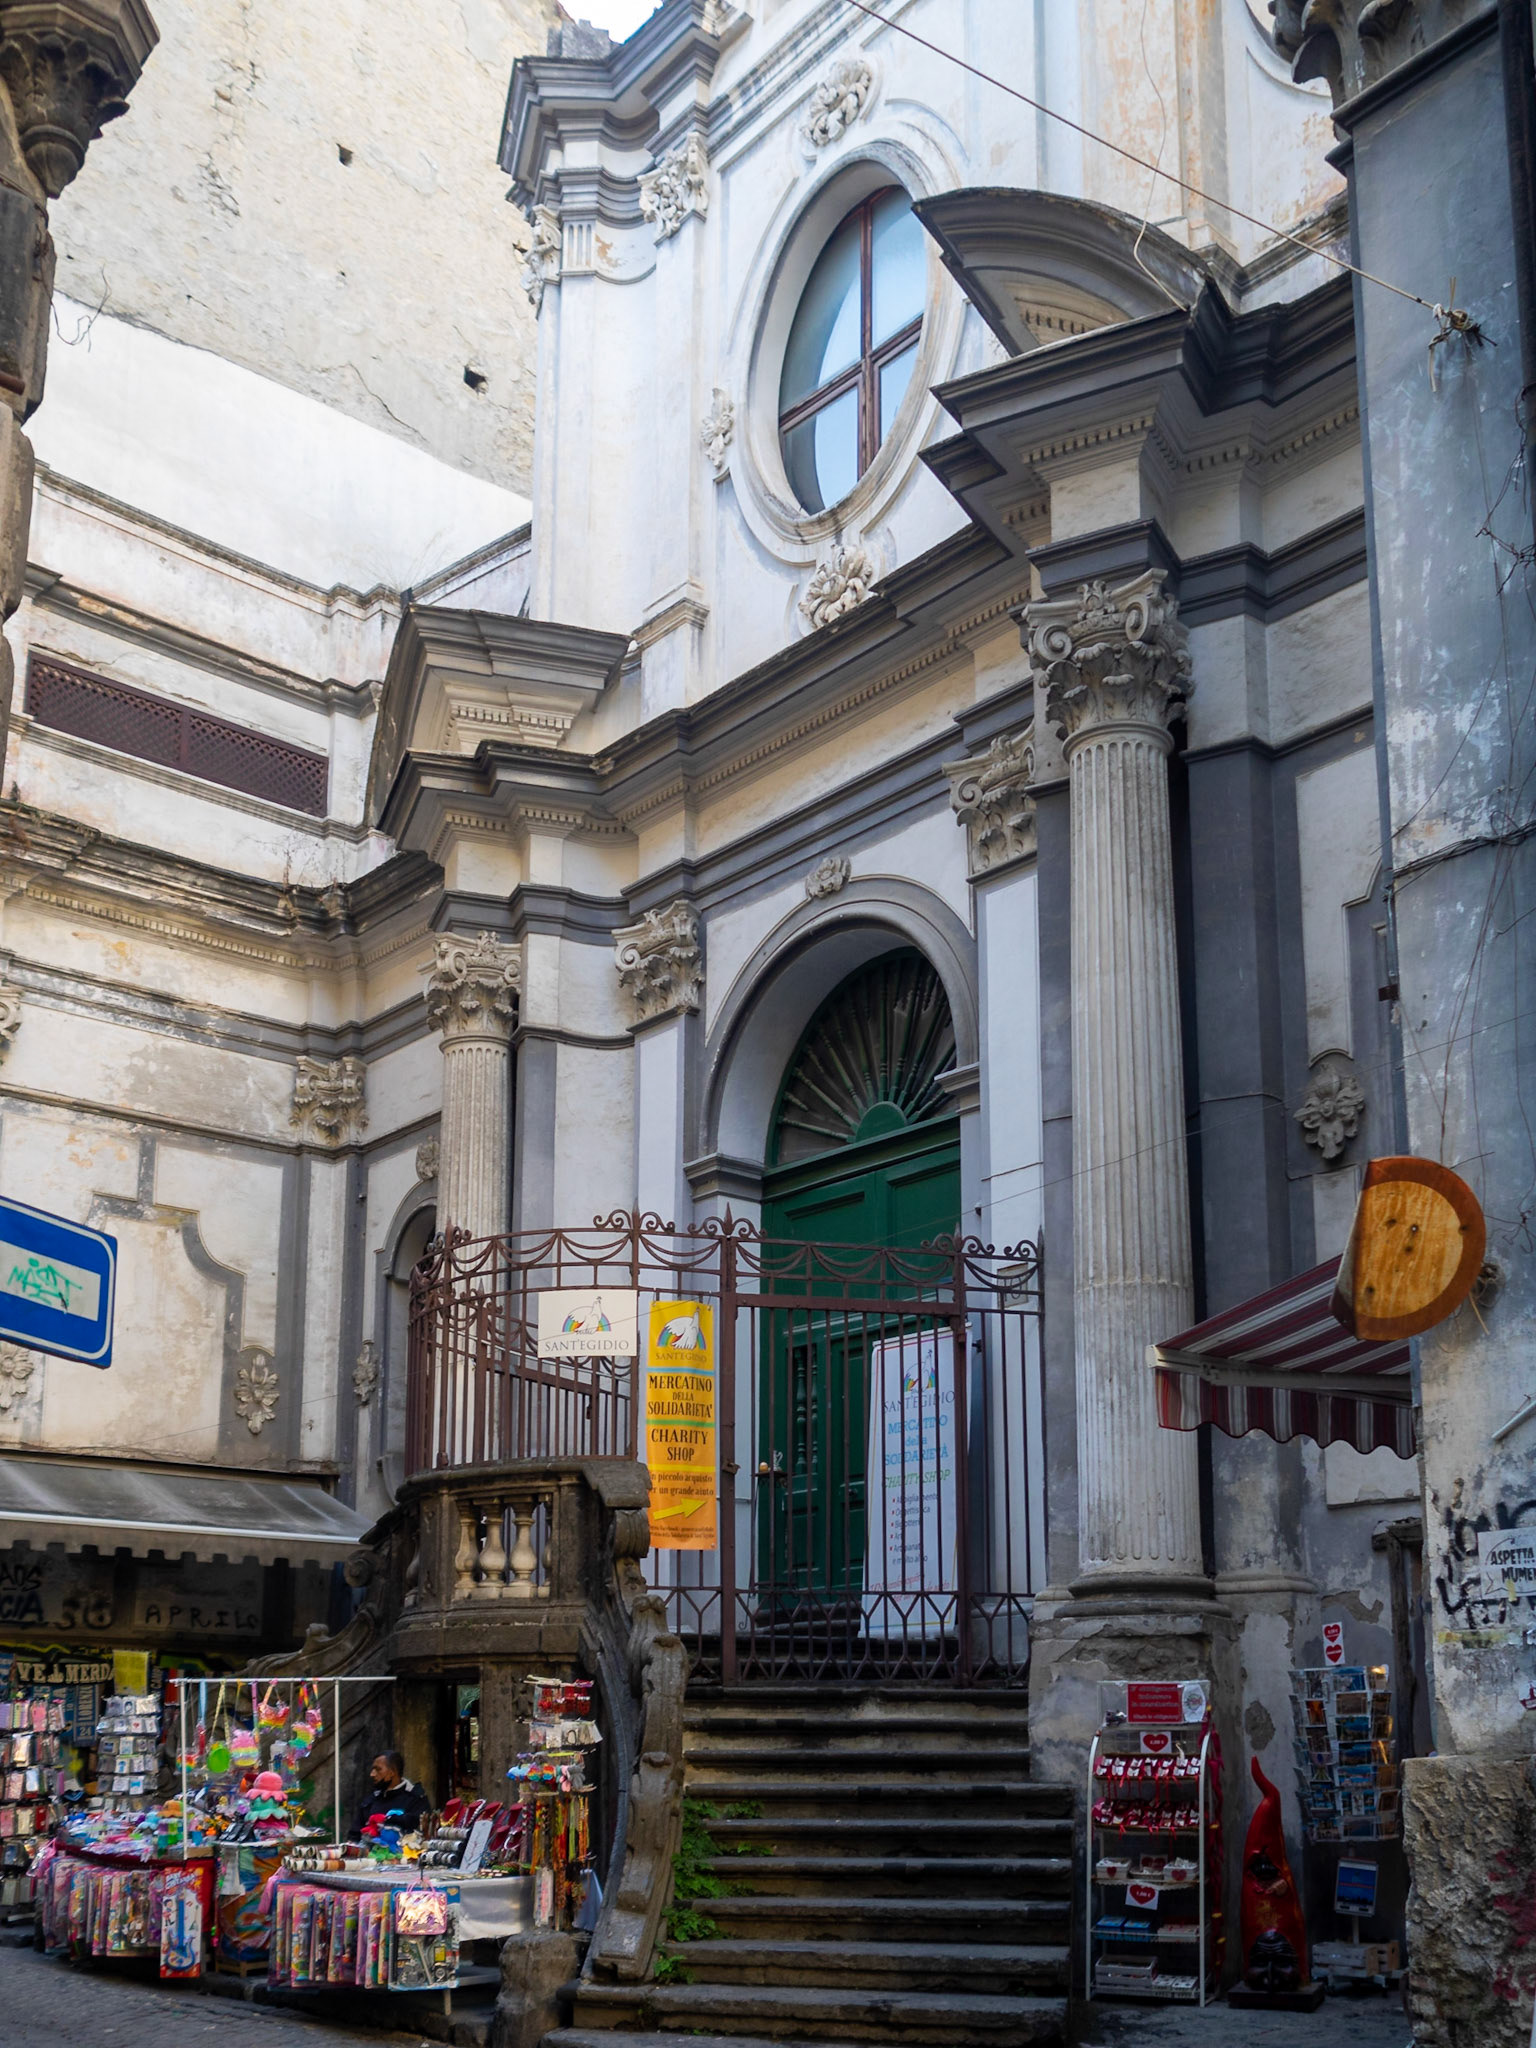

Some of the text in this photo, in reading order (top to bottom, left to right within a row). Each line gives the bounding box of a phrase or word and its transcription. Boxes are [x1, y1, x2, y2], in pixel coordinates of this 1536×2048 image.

[545, 1338, 629, 1351] SANT'EGIDIO
[649, 1375, 713, 1393] MERCATINO
[672, 1391, 694, 1401] DELLA
[888, 1414, 948, 1435] MERCATIO
[651, 1428, 709, 1445] CHARITY
[905, 1435, 927, 1446] dela
[667, 1446, 695, 1461] SHOP
[885, 1442, 949, 1466] SOLDARIEÀ
[658, 1472, 684, 1483] piccolo
[685, 1474, 713, 1484] acquisto
[884, 1472, 921, 1489] CHAITY
[670, 1485, 694, 1496] grande
[695, 1487, 714, 1496] aiuto
